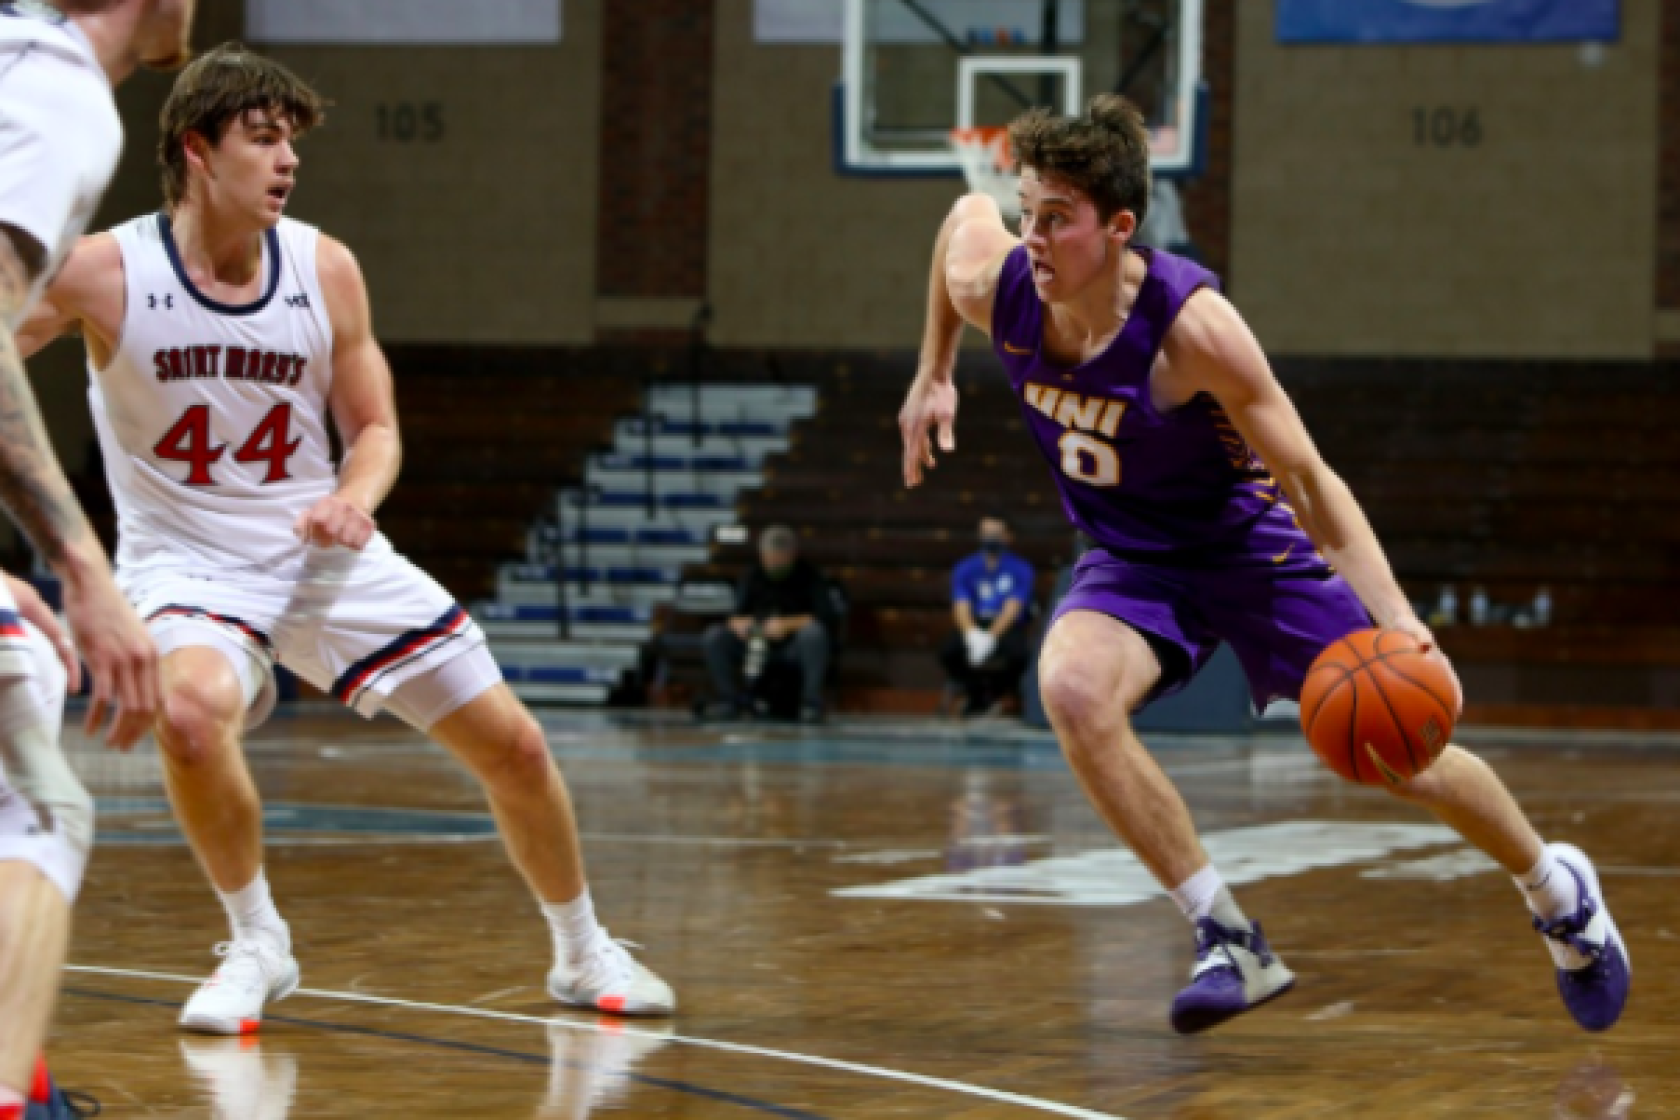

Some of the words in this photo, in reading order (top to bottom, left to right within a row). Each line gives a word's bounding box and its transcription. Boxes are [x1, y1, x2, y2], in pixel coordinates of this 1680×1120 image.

[374, 102, 445, 143] 105
[1411, 104, 1484, 148] 106
[153, 344, 222, 382] SAINT
[1023, 381, 1127, 439] UNI
[153, 401, 302, 486] 44
[1057, 430, 1122, 487] 0
